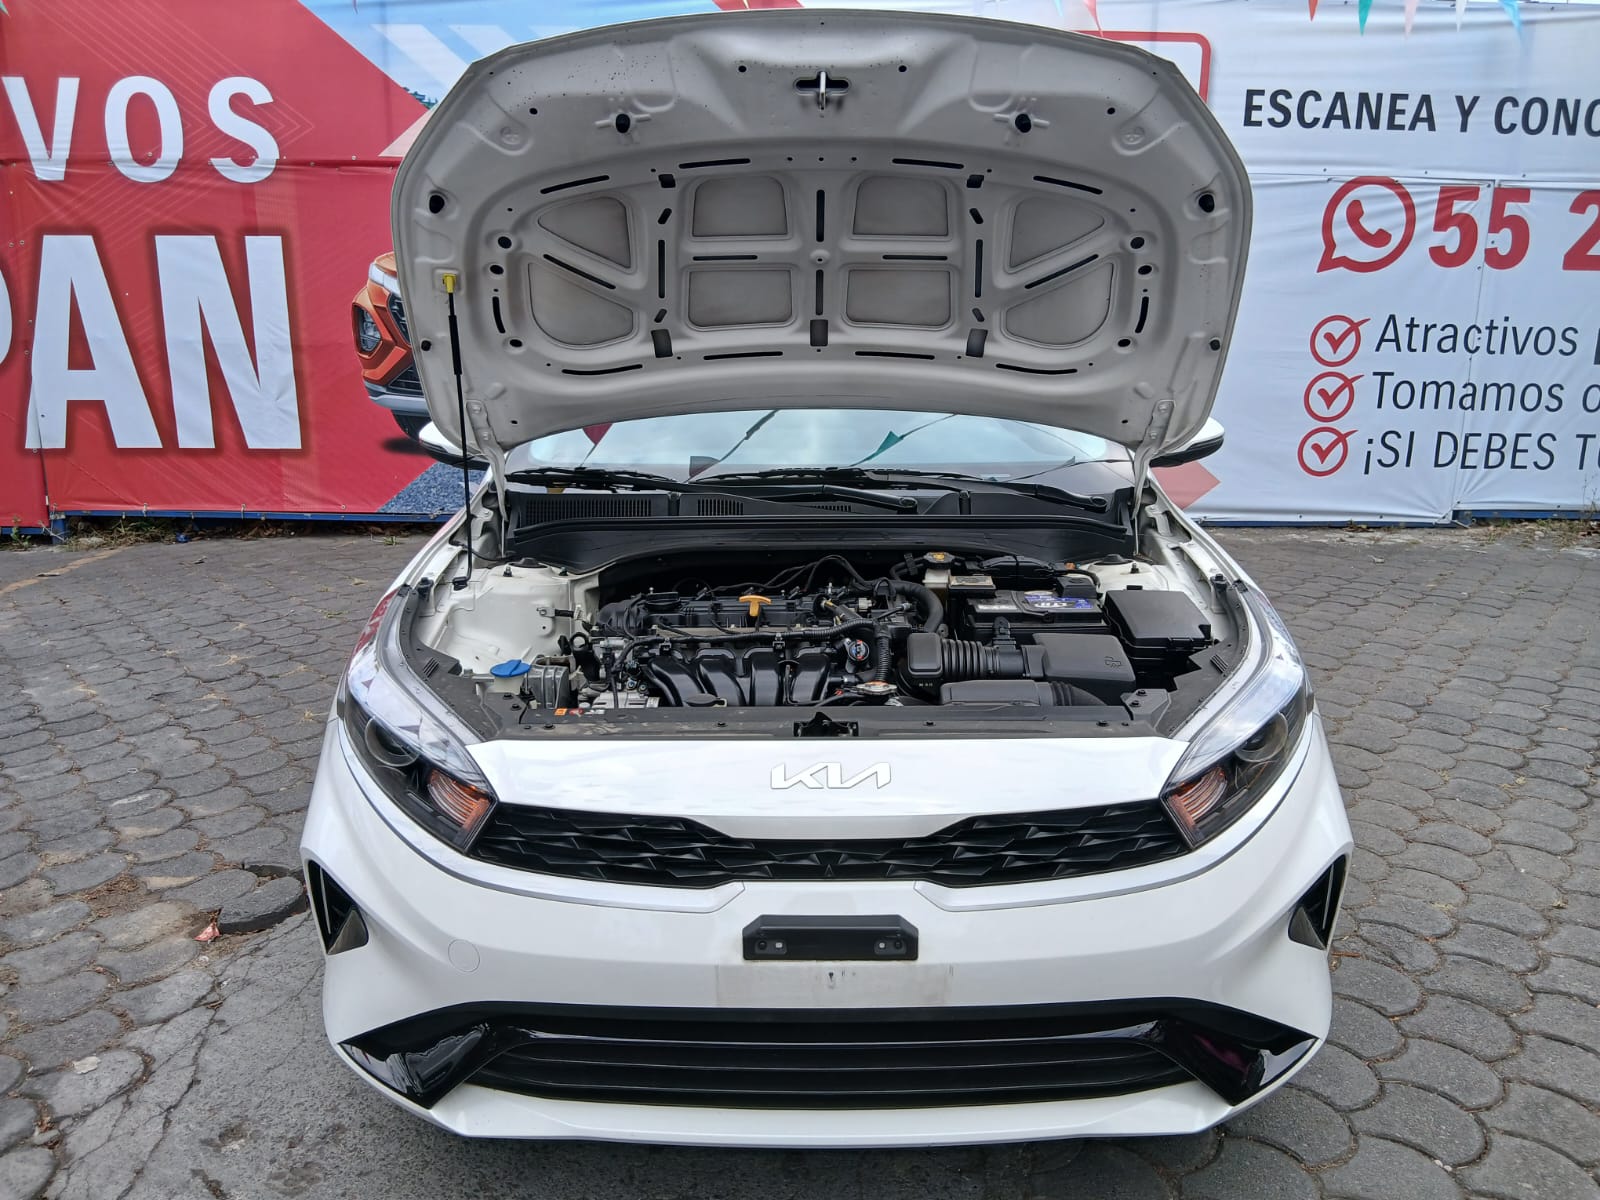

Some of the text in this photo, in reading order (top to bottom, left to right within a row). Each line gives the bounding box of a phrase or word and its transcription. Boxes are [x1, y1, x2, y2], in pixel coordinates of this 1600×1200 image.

[2, 75, 280, 183] VOS
[1243, 89, 1438, 131] ESCANEA
[1455, 95, 1480, 133] Y
[1428, 186, 1531, 269] 55
[0, 235, 302, 449] AN
[1375, 314, 1579, 356] Atractivos
[1372, 371, 1565, 412] Tomamos
[1363, 430, 1600, 475] ¡SI DEBES T
[771, 761, 892, 790] KIA
